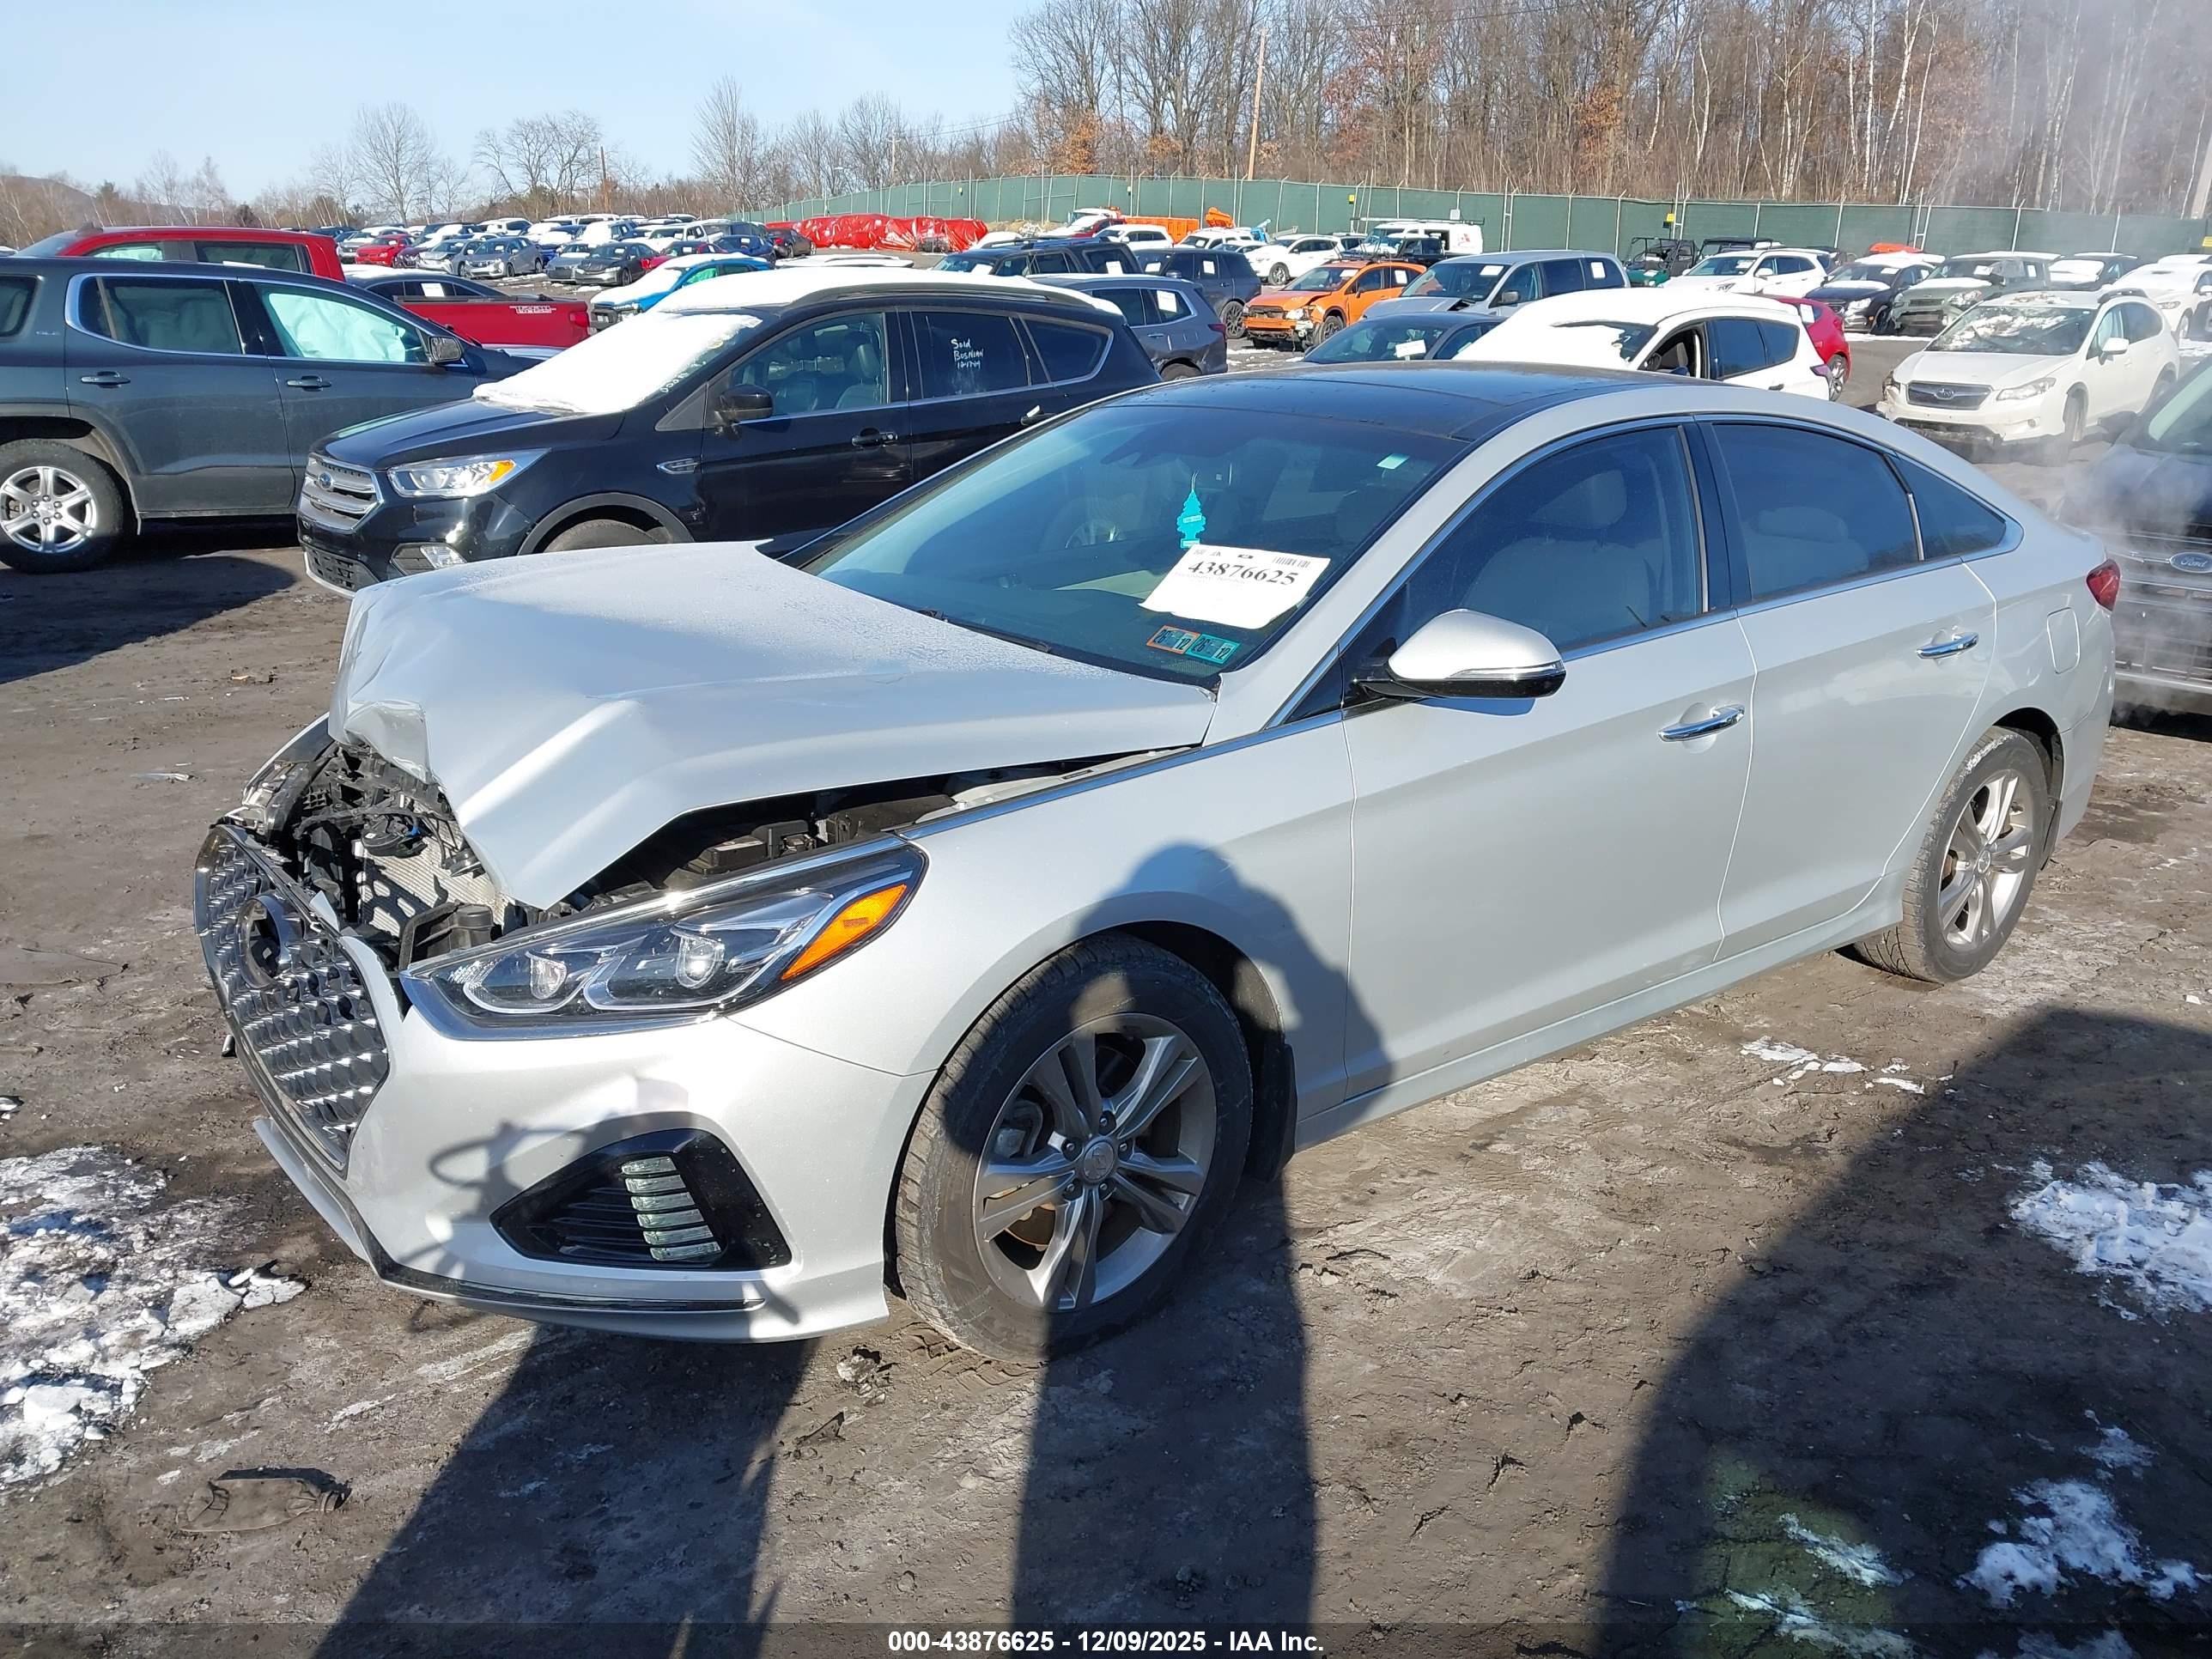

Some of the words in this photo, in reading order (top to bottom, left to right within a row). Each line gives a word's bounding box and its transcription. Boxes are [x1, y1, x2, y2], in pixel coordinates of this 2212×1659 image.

[951, 337, 971, 349] Sold
[1188, 560, 1298, 585] 43876625
[1176, 638, 1191, 650] 12
[1215, 647, 1231, 660] 12
